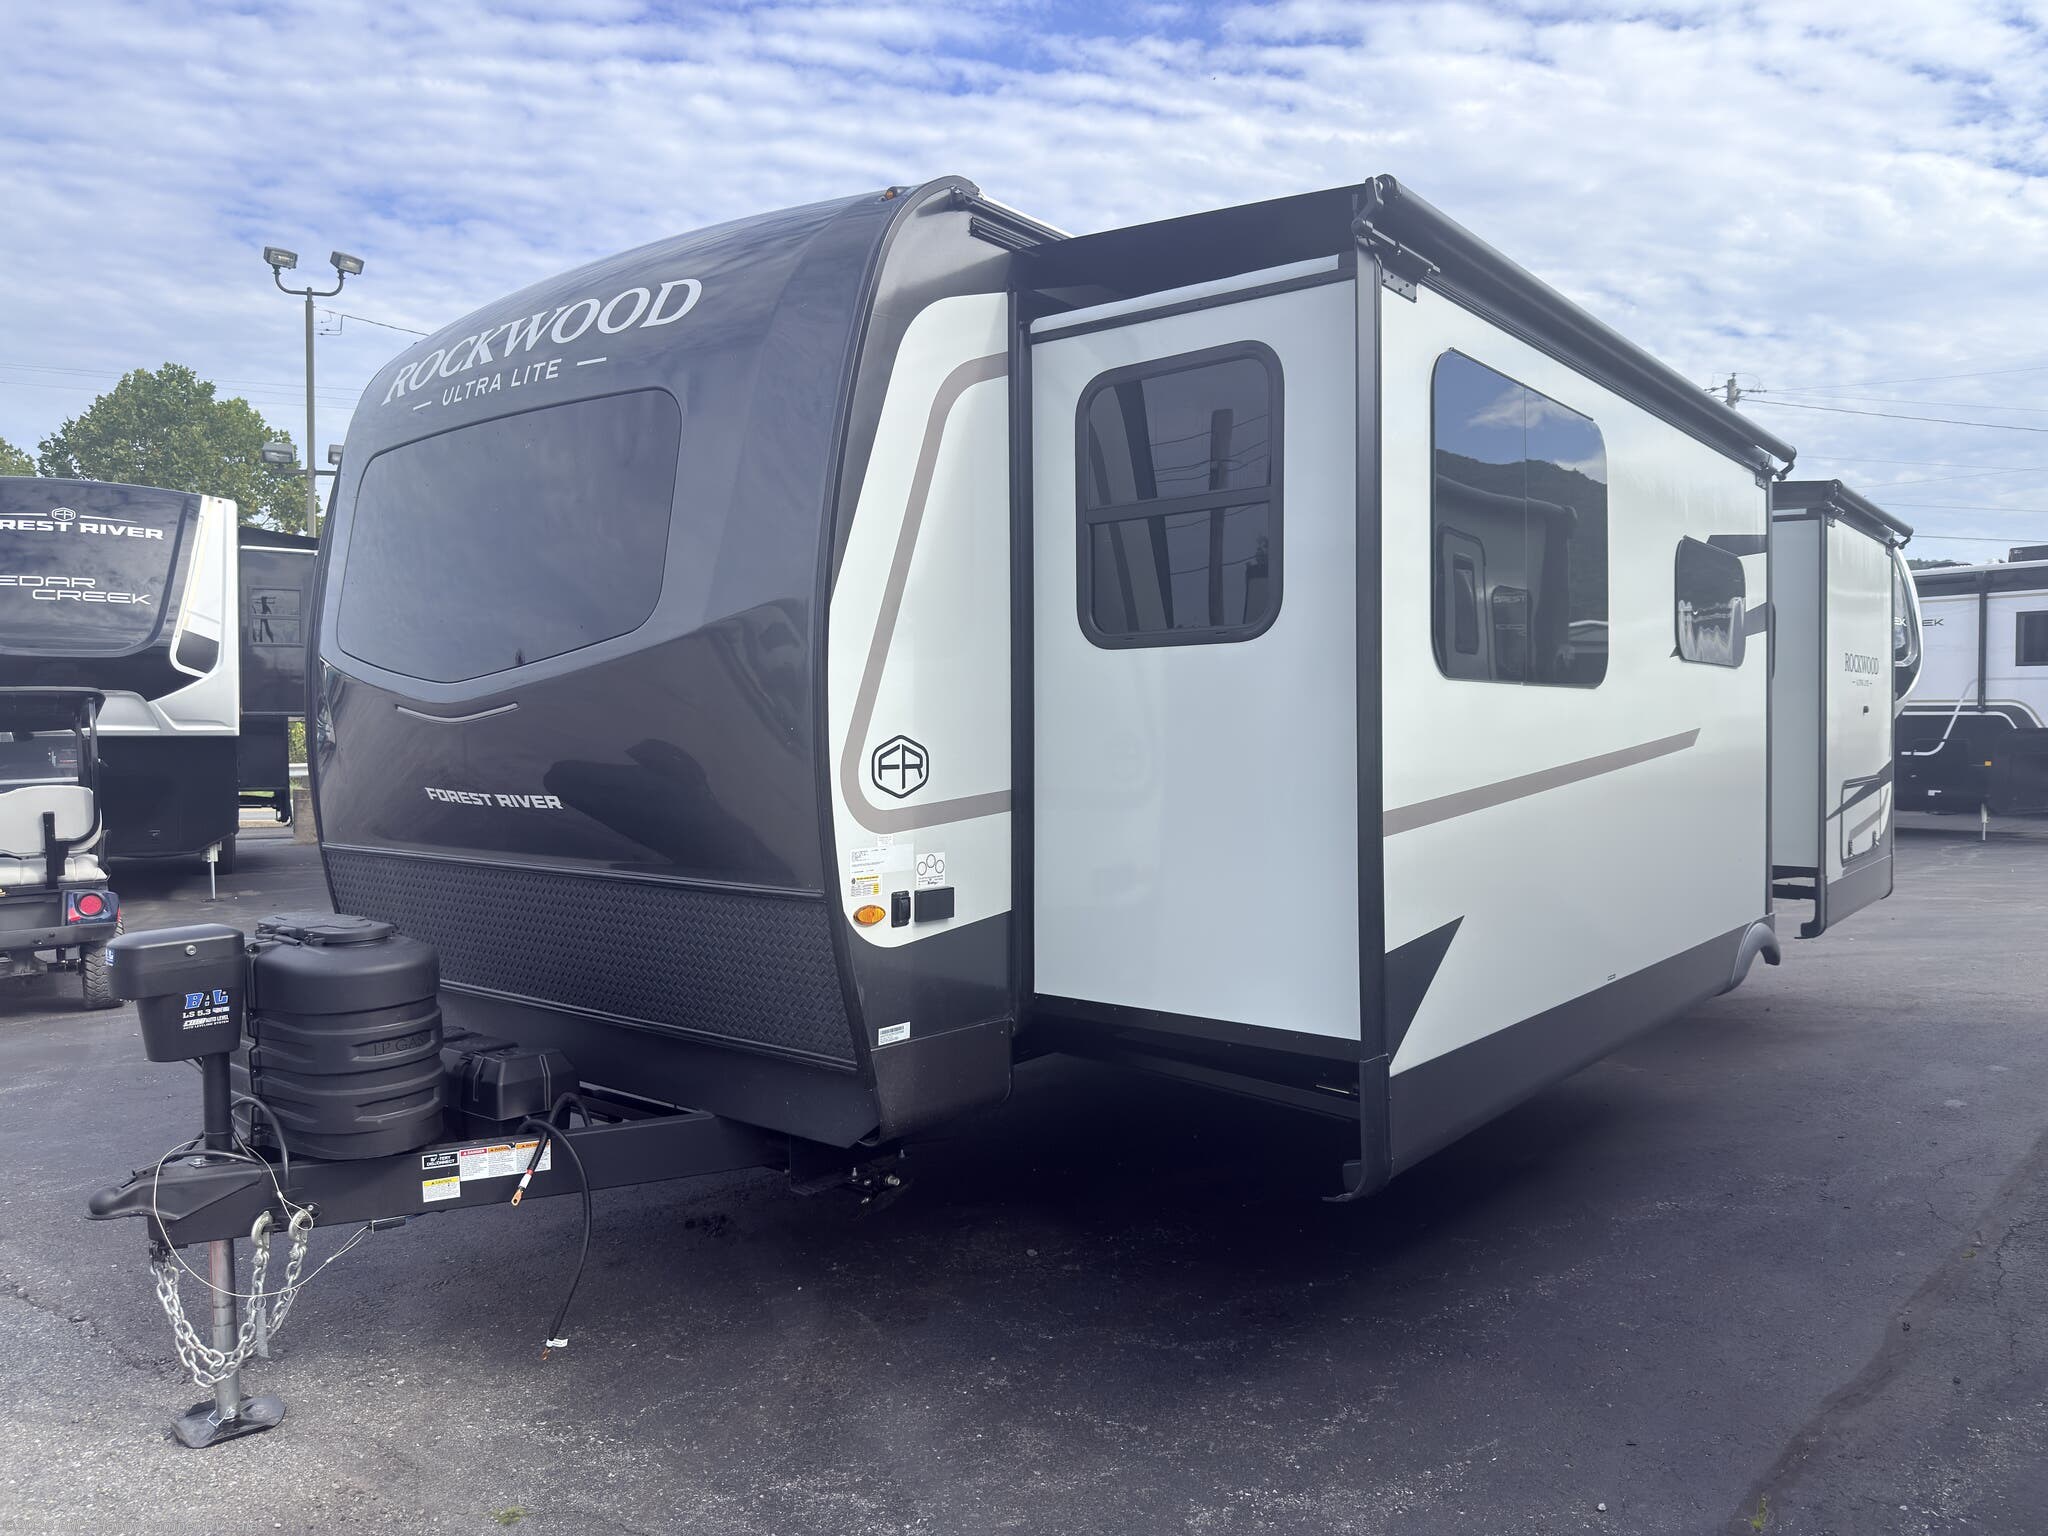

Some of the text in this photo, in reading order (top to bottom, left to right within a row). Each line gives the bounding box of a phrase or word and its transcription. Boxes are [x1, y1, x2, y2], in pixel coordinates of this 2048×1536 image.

[381, 278, 703, 406] ROCKWOOD
[442, 358, 563, 406] ULTRA LITE
[0, 519, 164, 540] REST RIVER
[0, 575, 96, 589] EDAR
[32, 589, 152, 605] CREEK
[1844, 652, 1880, 675] ROCKWOOD
[424, 786, 564, 810] FOREST RIVER
